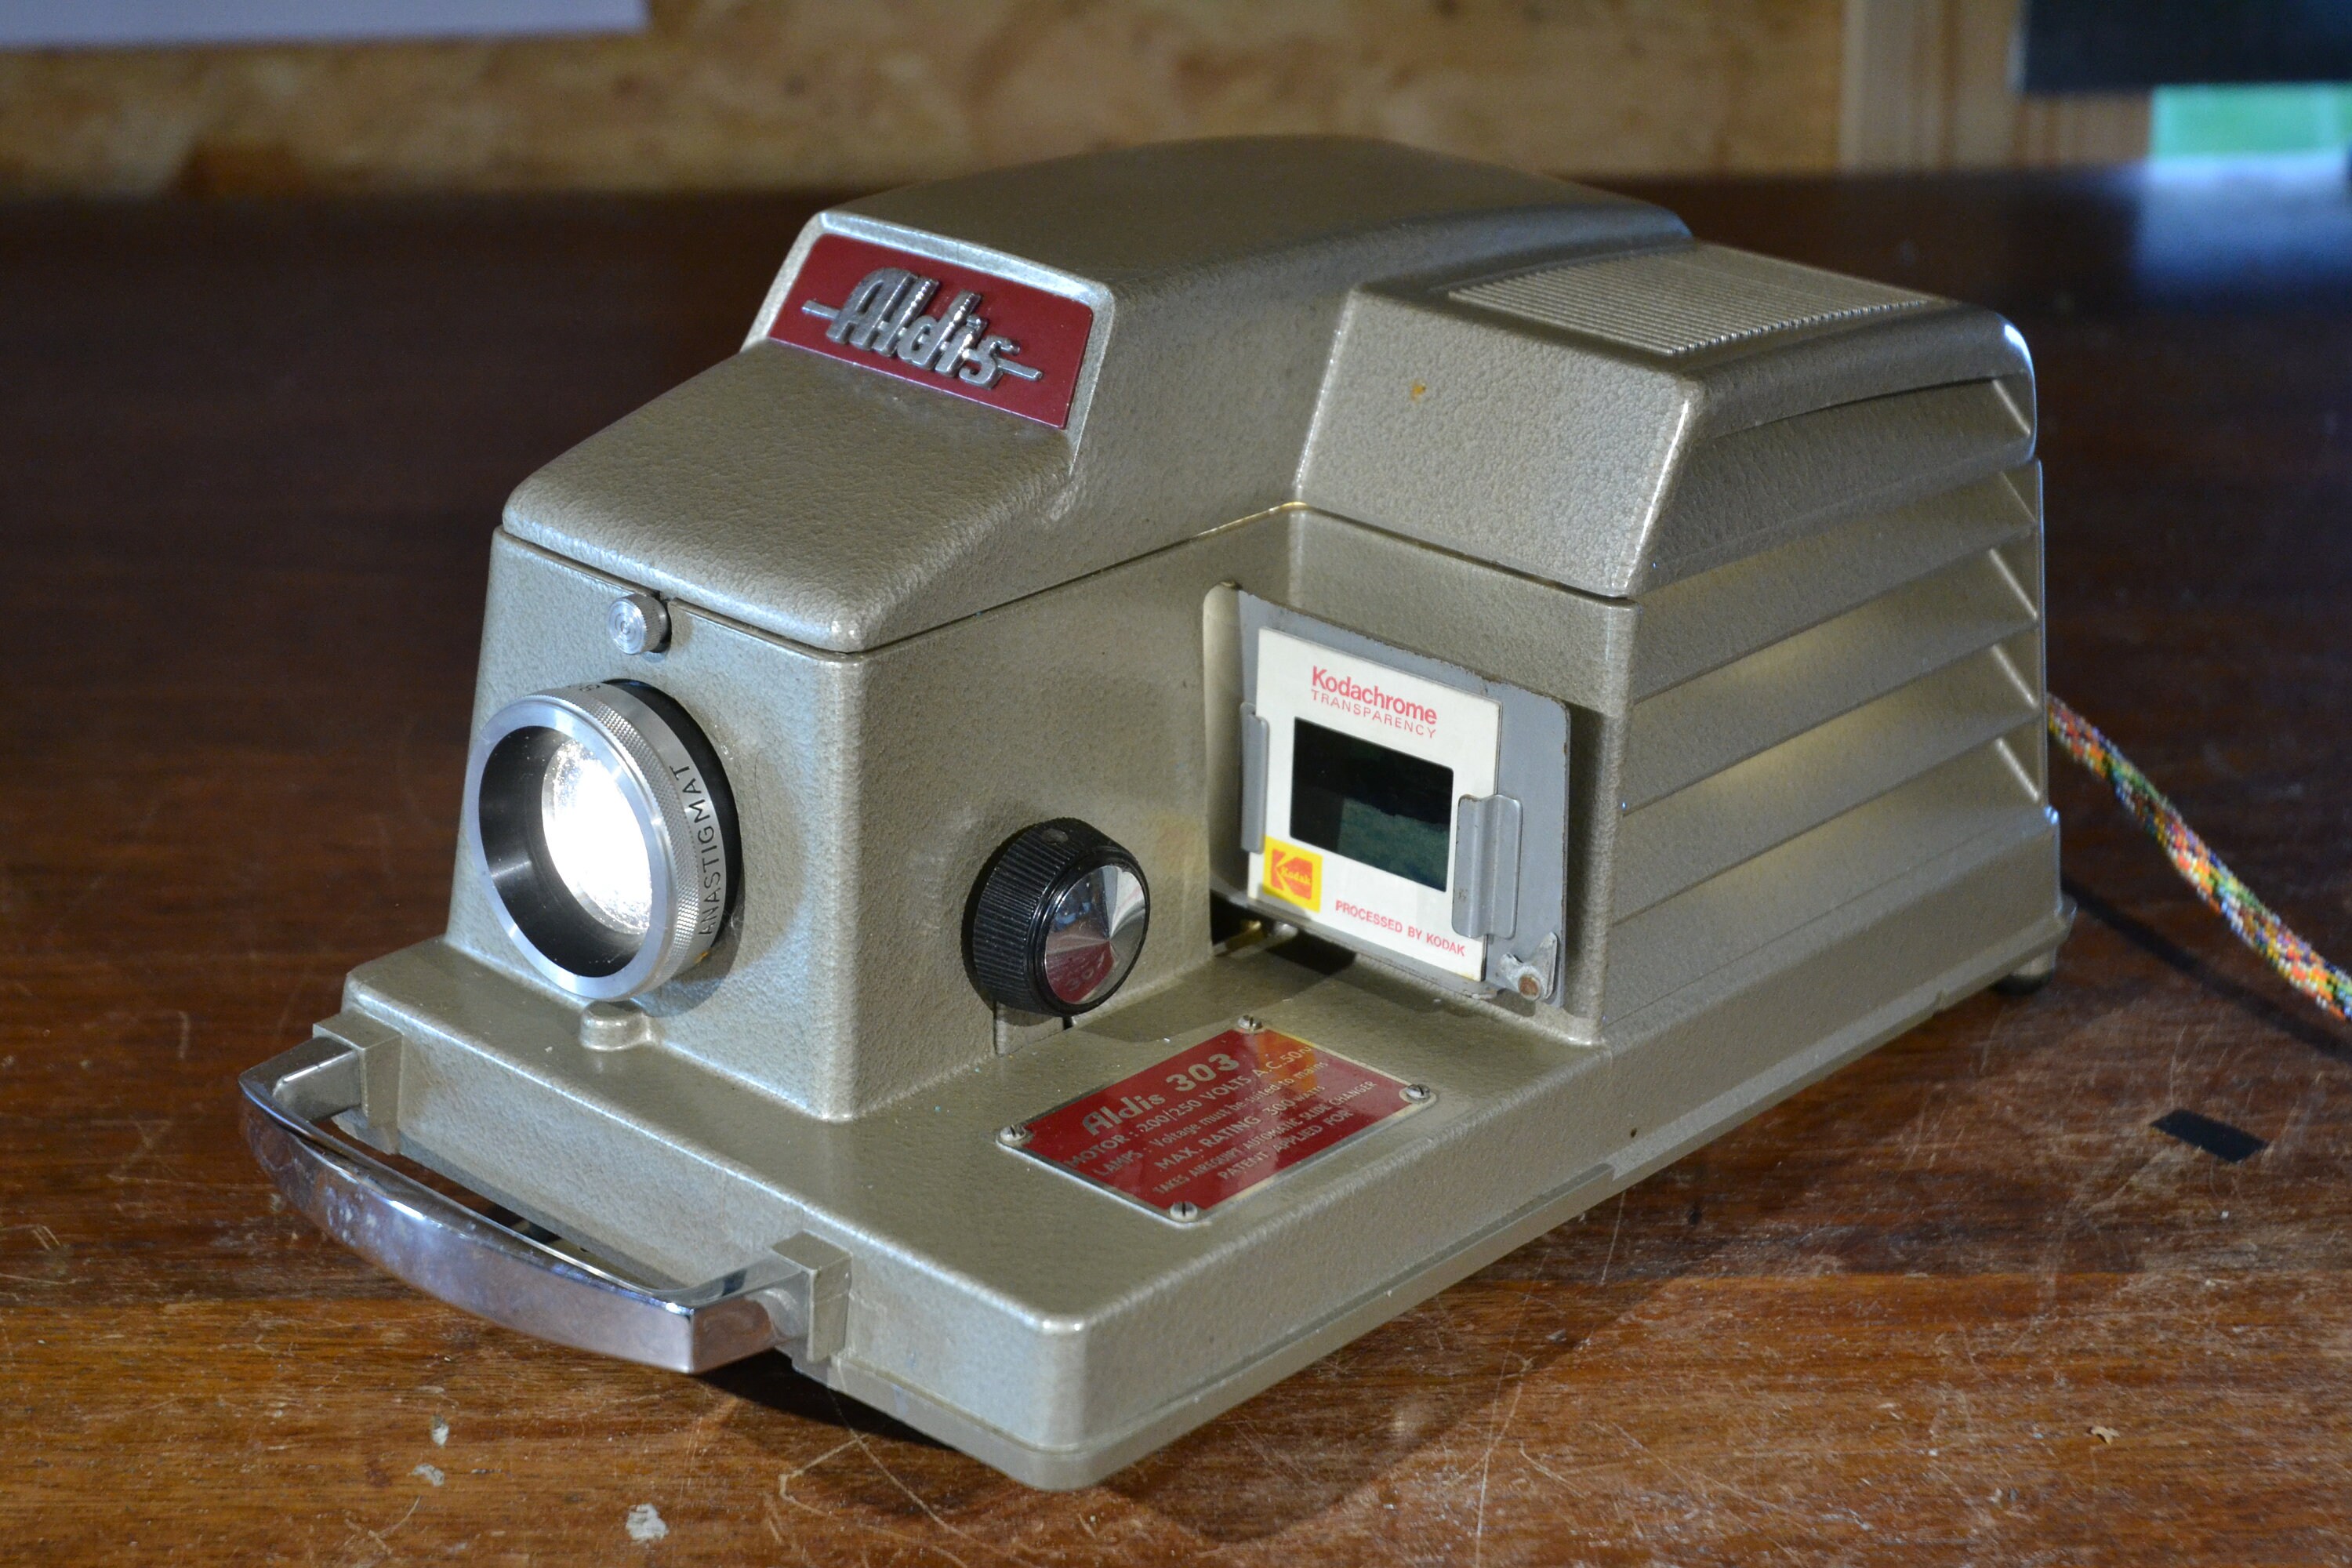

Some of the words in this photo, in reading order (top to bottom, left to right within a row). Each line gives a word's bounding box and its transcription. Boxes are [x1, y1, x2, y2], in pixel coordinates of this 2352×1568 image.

[801, 267, 1044, 390] Aldis
[1311, 689, 1437, 739] TRANSPARENCY
[1312, 665, 1437, 725] Kodachrome
[670, 765, 721, 935] ANASTIGMAT
[1279, 866, 1312, 886] Kodak
[1335, 899, 1403, 933] PROCESSED
[1408, 926, 1422, 940] BY
[1426, 933, 1465, 956] KODAK
[1082, 1094, 1166, 1135] Aldis
[1166, 1053, 1240, 1091] 303
[1137, 1099, 1203, 1133] 200/250
[1199, 1075, 1252, 1101] VOLTS
[1149, 1123, 1201, 1148] Voltage
[1199, 1109, 1230, 1125] must
[1231, 1100, 1247, 1112] be
[1245, 1083, 1282, 1103] suited
[1278, 1077, 1294, 1087] to
[1293, 1061, 1329, 1080] mains
[1154, 1147, 1203, 1170] MAX.
[1198, 1116, 1261, 1148] RATING
[1261, 1098, 1297, 1116] 300
[1294, 1085, 1326, 1102] WATTS
[1152, 1174, 1190, 1194] TAKES
[1244, 1118, 1303, 1151] AUTOMATIC
[1299, 1103, 1333, 1121] SLIDE
[1328, 1080, 1377, 1106] CHANGER
[1218, 1151, 1269, 1179] PATENT
[1272, 1124, 1323, 1152] APPLIED
[1323, 1109, 1354, 1126] FOR
